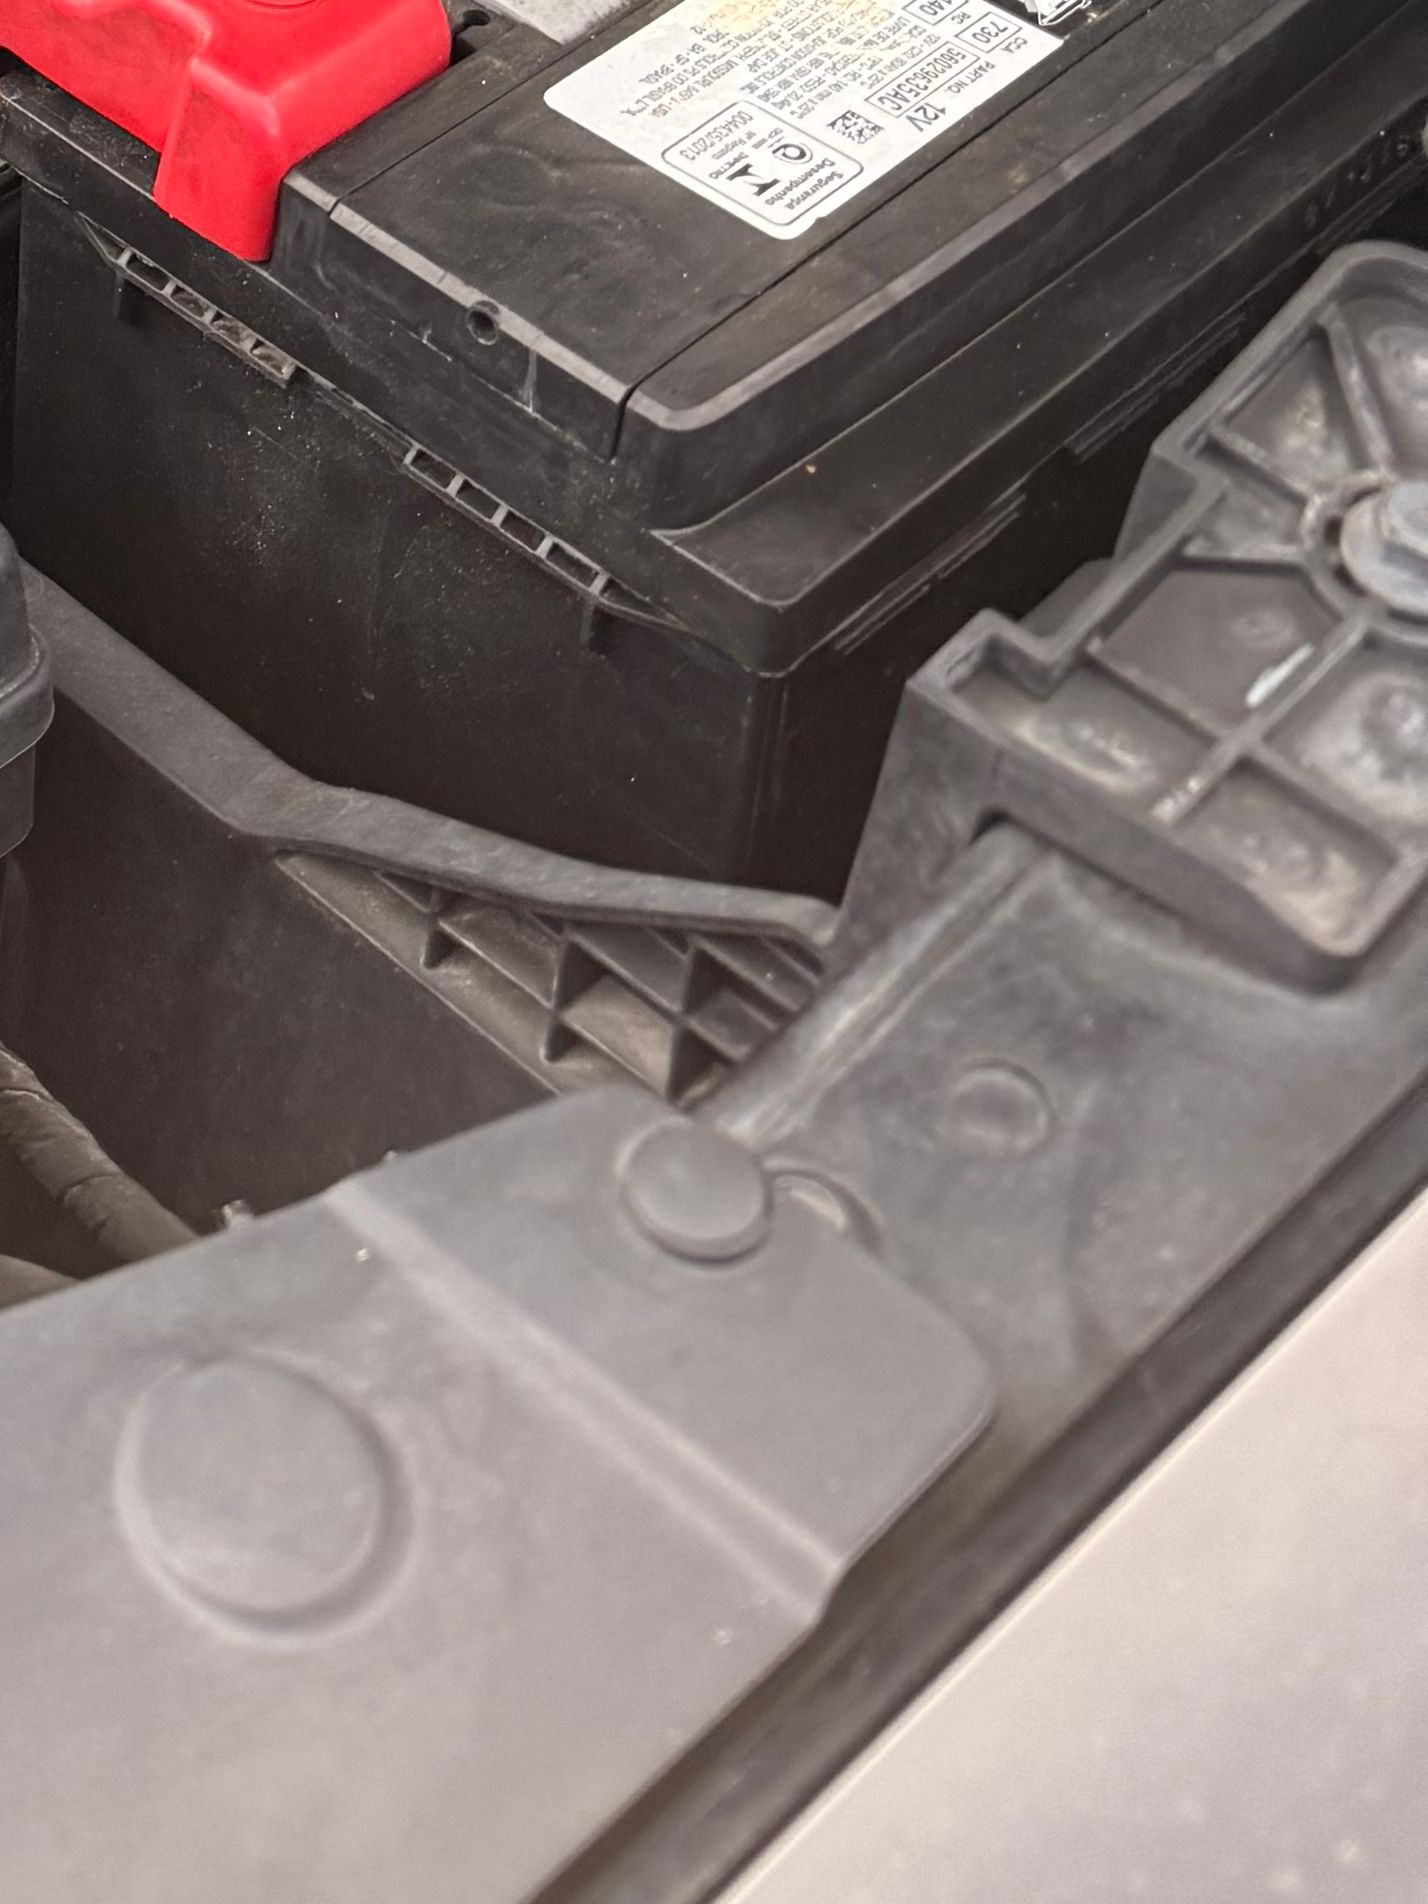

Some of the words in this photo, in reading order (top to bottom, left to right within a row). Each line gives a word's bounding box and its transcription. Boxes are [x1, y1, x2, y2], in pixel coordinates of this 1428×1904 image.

[970, 20, 1009, 44] 730
[1000, 35, 1028, 54] CCA
[876, 46, 967, 111] 56029635AC
[946, 79, 969, 94] NO.
[964, 59, 996, 84] PART
[904, 101, 946, 132] 12V
[678, 109, 754, 161] 004435/2013
[763, 156, 836, 206] Desempenho
[783, 169, 844, 210] Segurança
